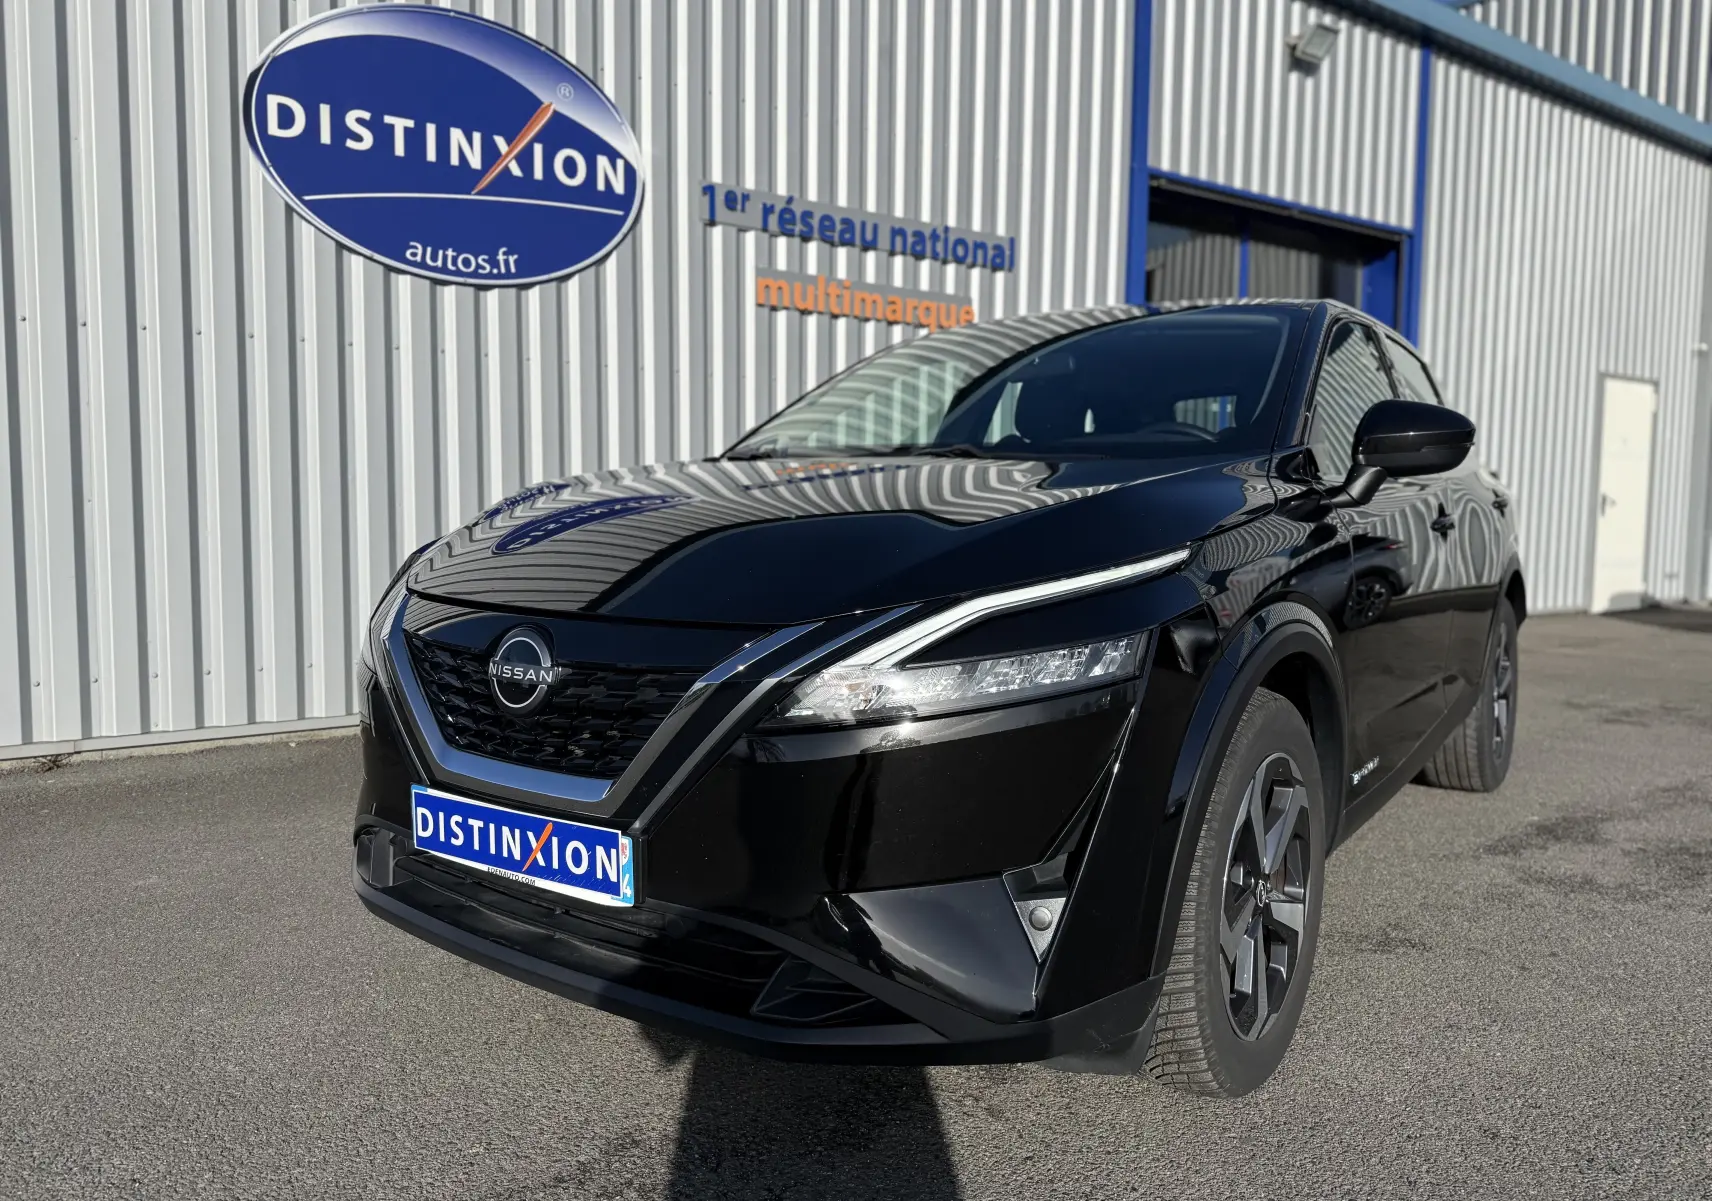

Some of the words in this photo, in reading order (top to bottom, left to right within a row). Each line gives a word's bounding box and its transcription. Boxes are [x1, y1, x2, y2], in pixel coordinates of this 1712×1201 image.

[265, 93, 625, 195] DISTINXION
[404, 241, 519, 275] autos.fr
[701, 184, 750, 222] 1er
[761, 195, 879, 249] réseau
[890, 225, 1016, 272] national
[756, 275, 975, 333] multimarque
[489, 662, 553, 683] NISSAN
[416, 806, 618, 883] DISTINXION
